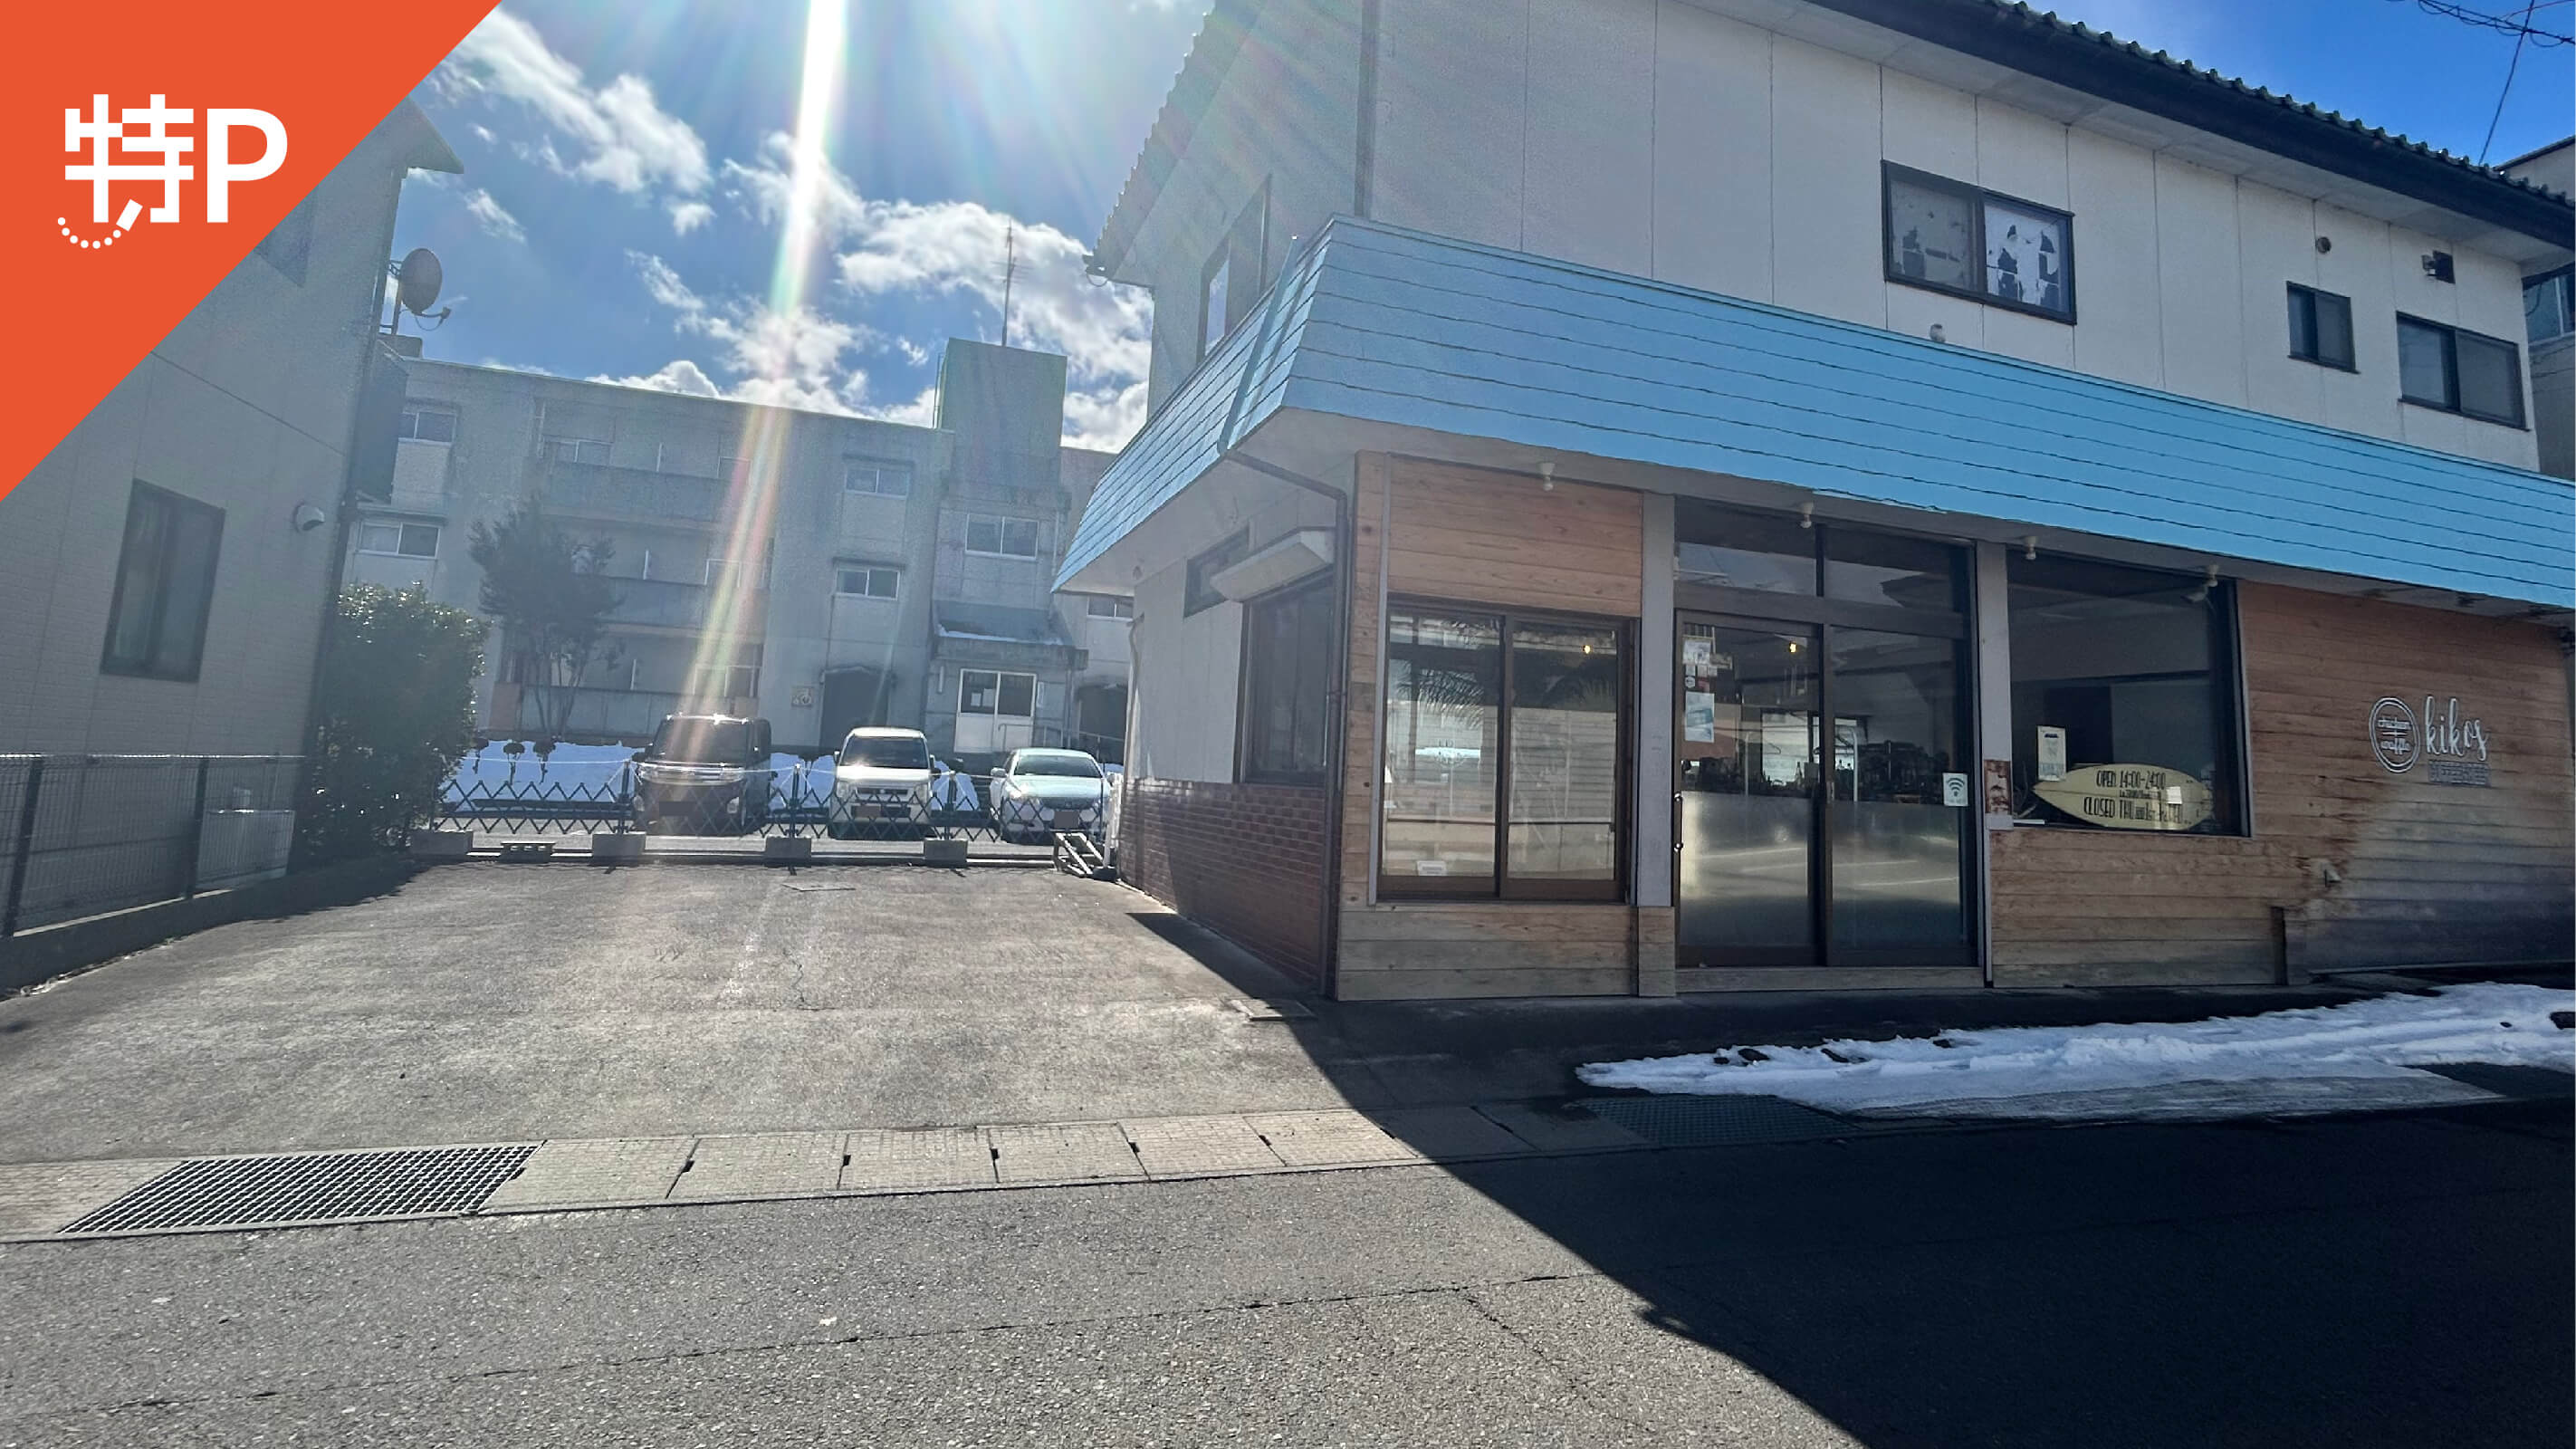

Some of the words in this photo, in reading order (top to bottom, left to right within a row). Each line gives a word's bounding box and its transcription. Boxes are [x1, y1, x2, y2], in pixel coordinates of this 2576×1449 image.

[2425, 696, 2488, 762] kikos
[2096, 770, 2117, 787] OPEN
[2083, 796, 2116, 819] CLOSED
